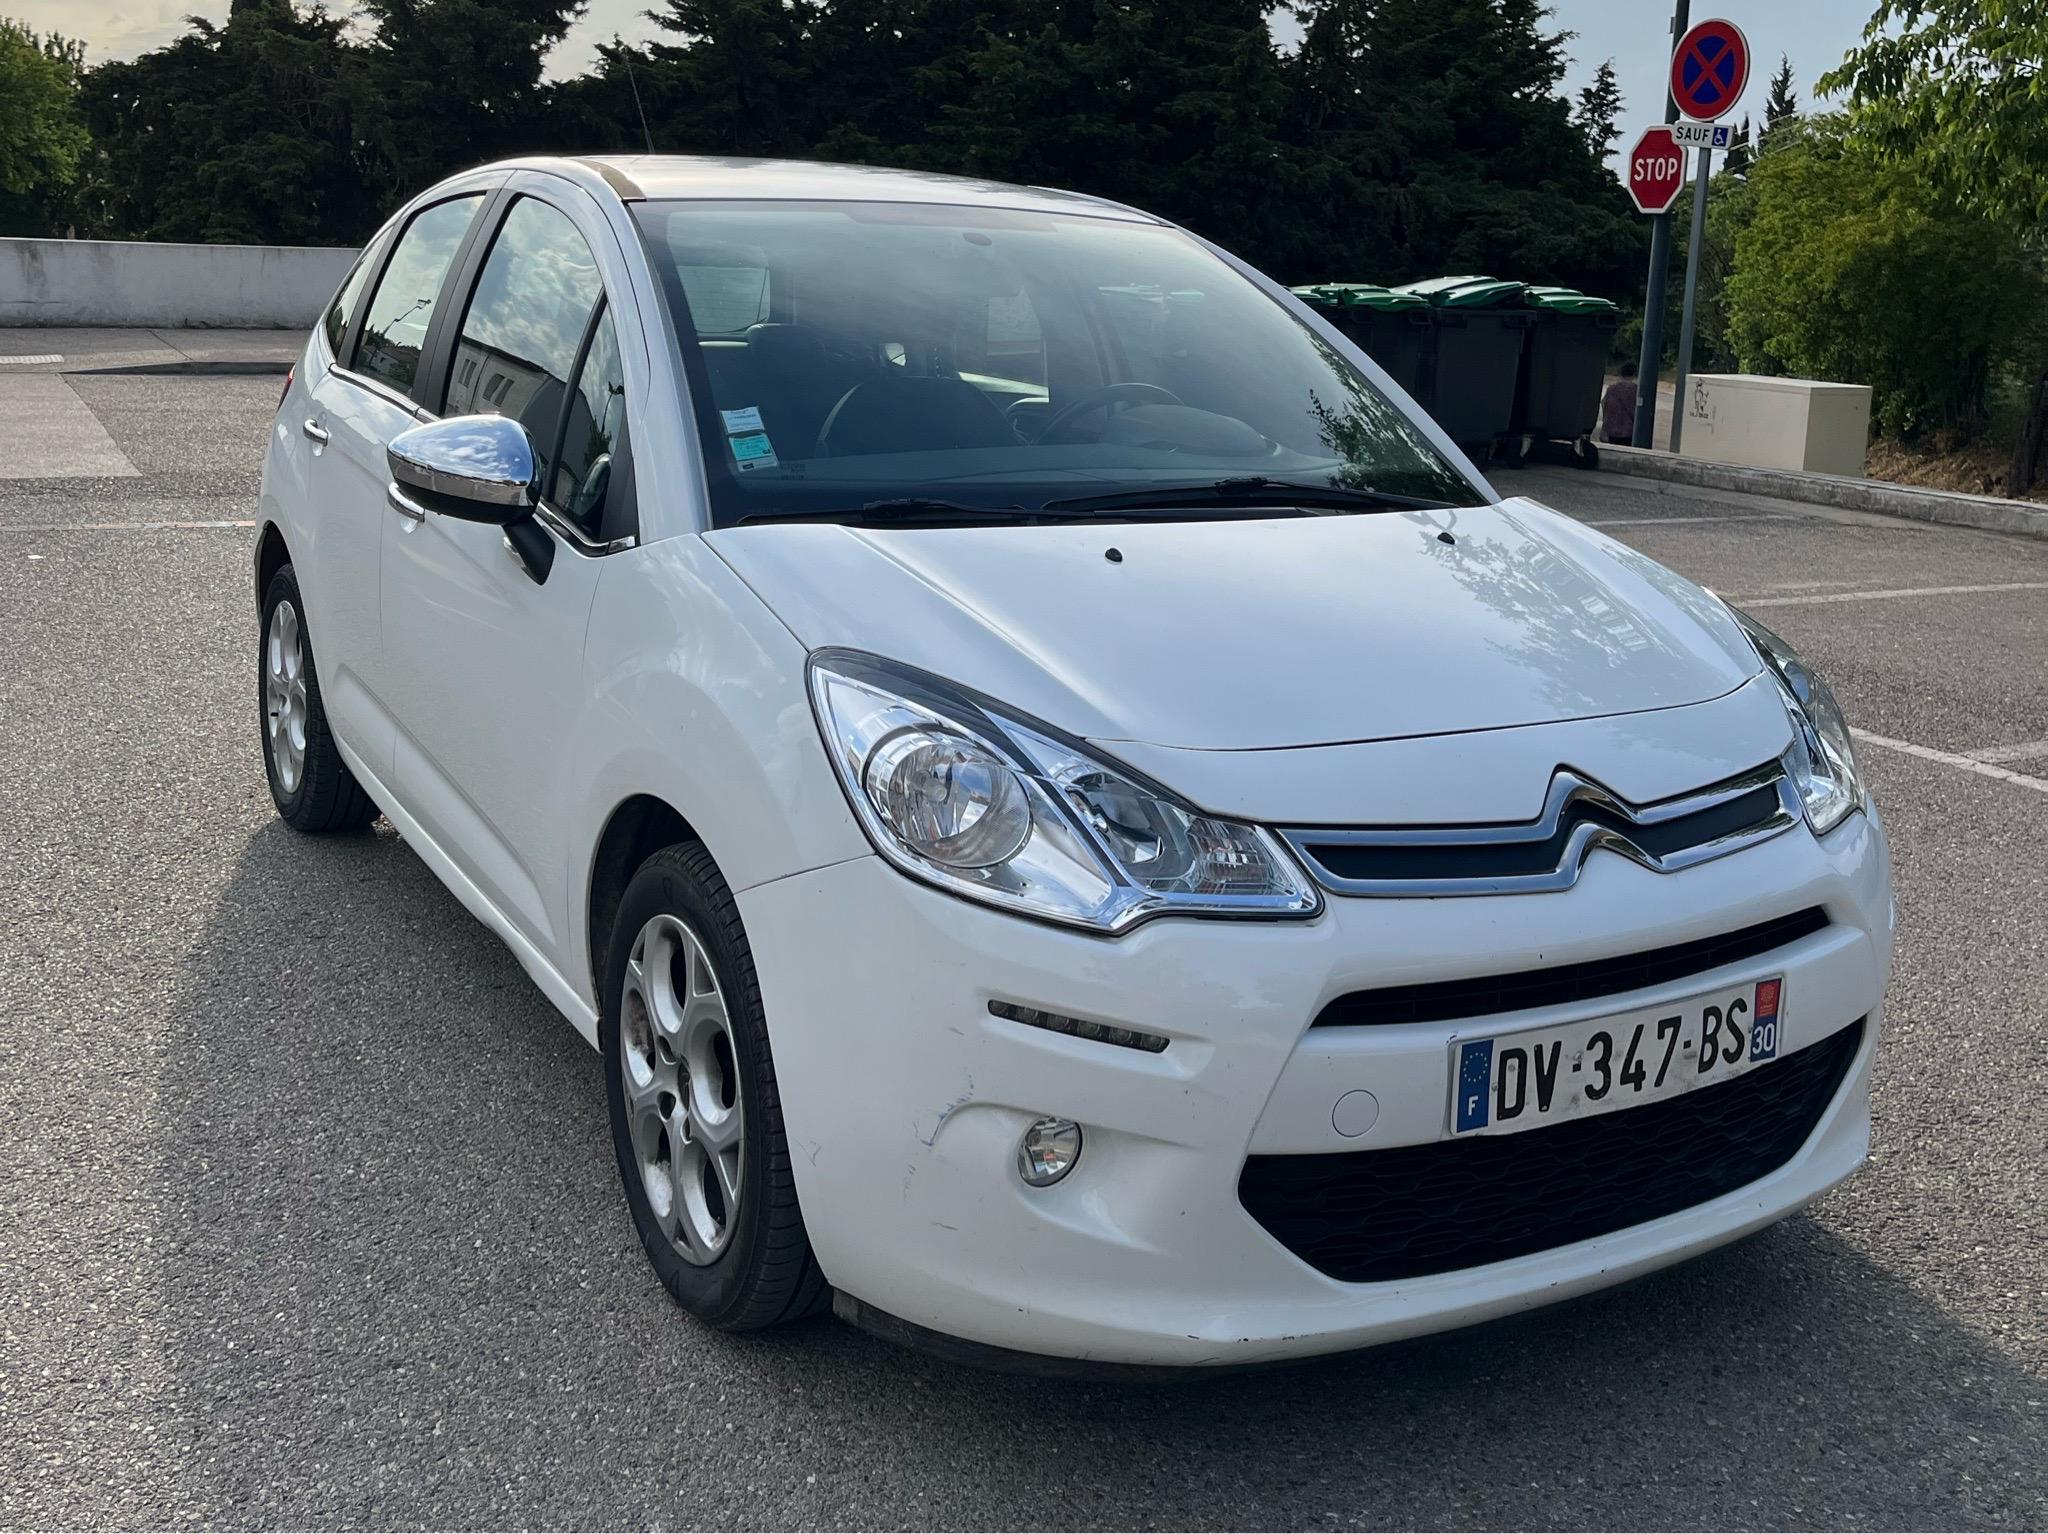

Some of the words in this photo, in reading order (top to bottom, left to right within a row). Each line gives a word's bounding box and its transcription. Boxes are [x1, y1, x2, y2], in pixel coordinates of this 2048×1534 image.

[1676, 126, 1711, 142] SAUF
[1634, 157, 1678, 181] STOP
[1752, 1023, 1775, 1055] 30
[1496, 997, 1748, 1121] DV-347-BS
[1468, 1095, 1479, 1116] F
